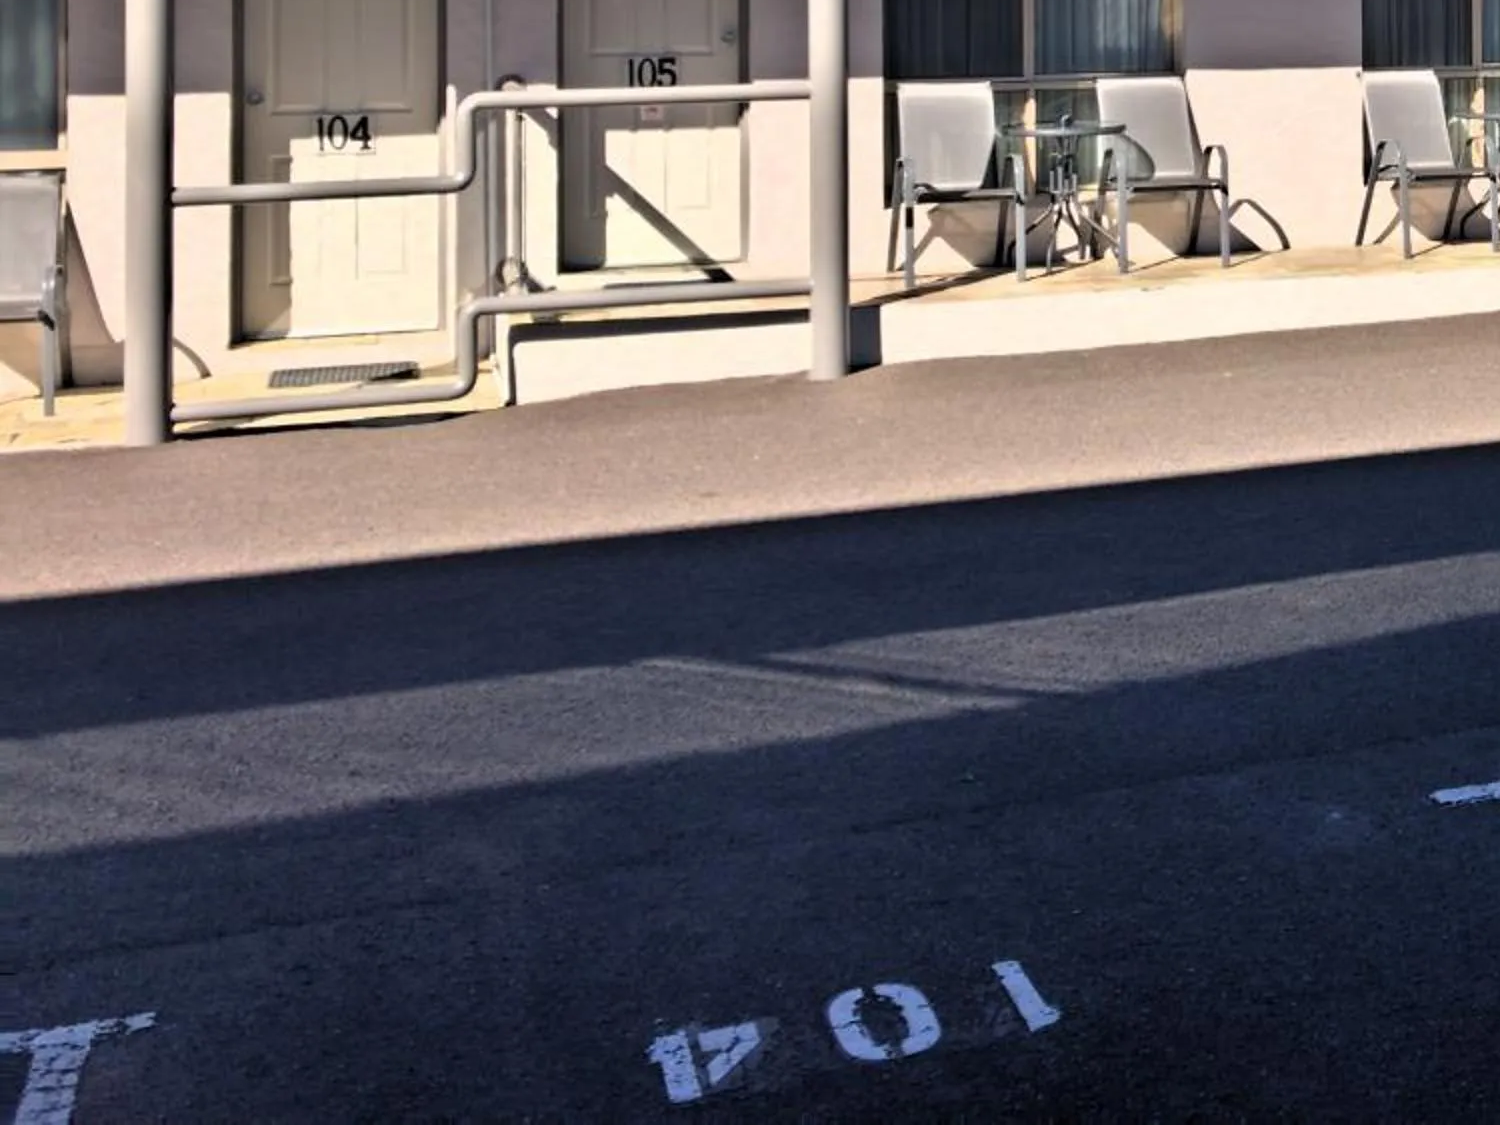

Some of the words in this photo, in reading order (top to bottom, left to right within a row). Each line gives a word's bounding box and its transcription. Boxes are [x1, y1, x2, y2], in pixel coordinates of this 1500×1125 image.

[628, 57, 677, 88] 105
[317, 115, 372, 152] 104
[646, 959, 1061, 1104] 104
